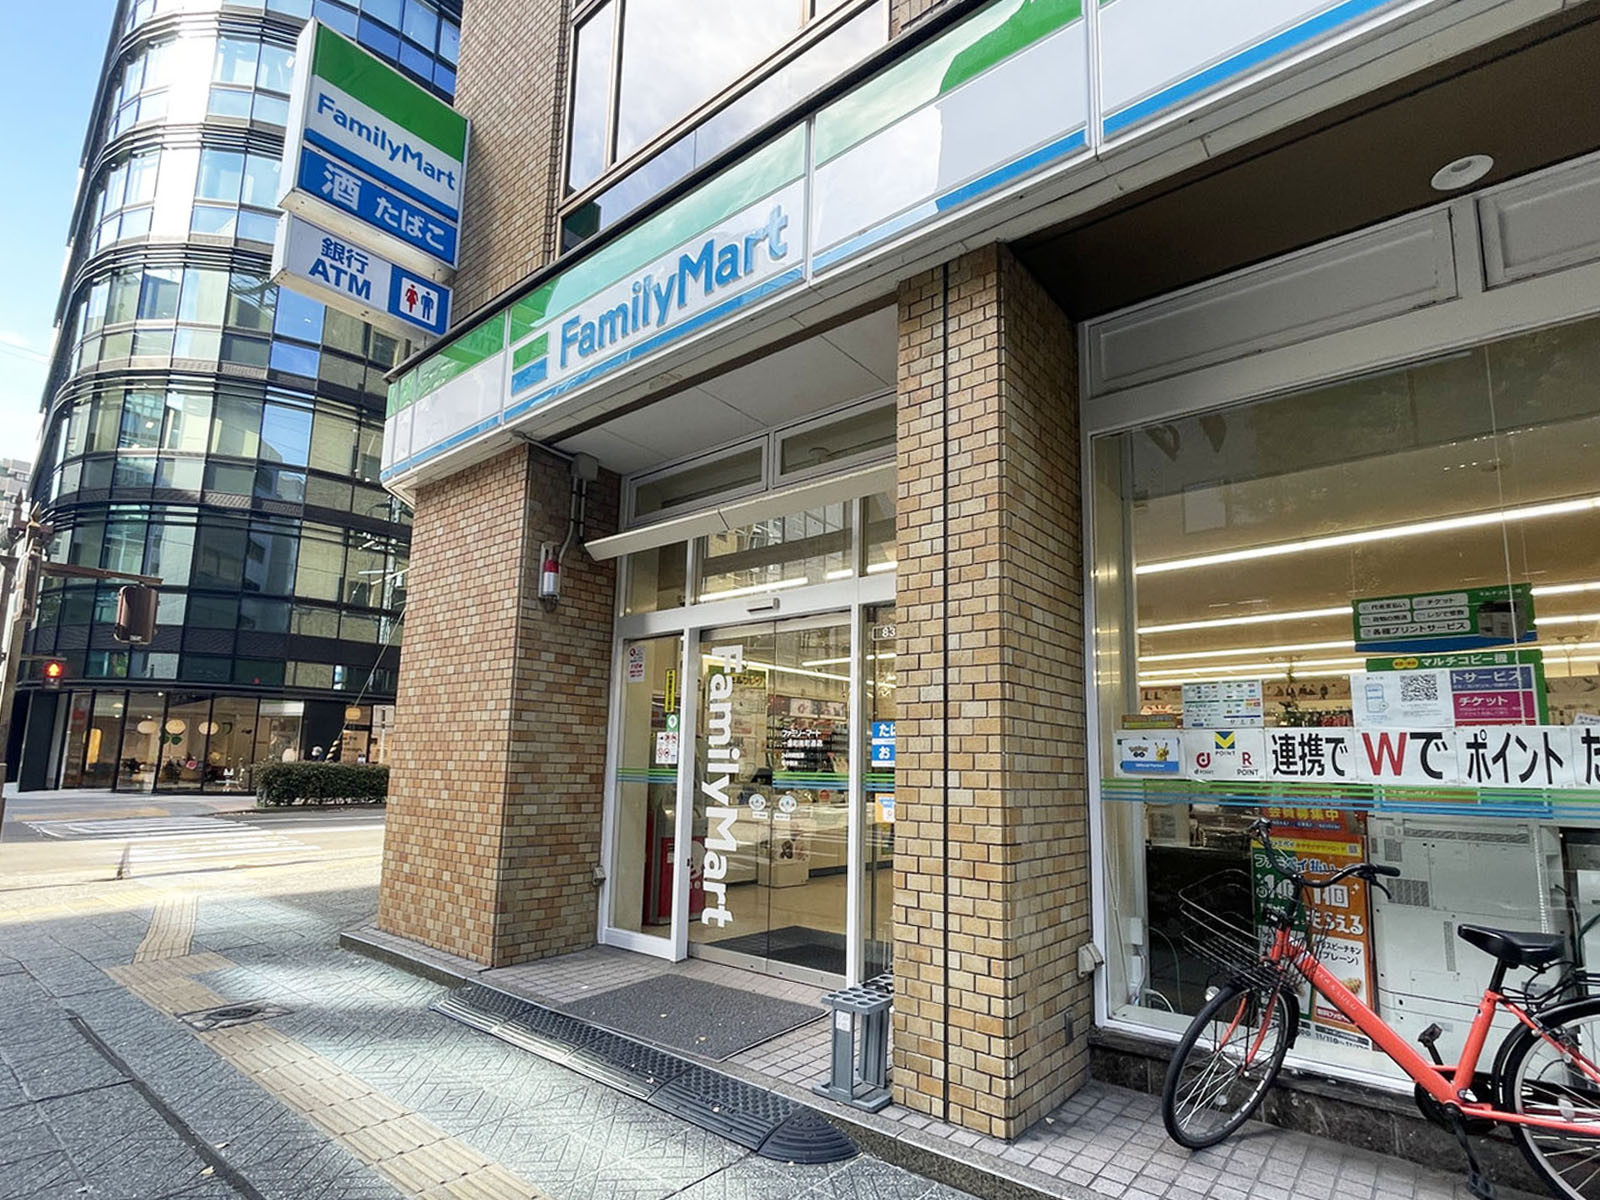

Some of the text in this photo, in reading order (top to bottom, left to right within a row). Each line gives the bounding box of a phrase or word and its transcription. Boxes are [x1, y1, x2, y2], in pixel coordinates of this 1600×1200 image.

[316, 92, 456, 191] FamilyMart
[321, 162, 445, 251] 酒 たばこ
[321, 237, 369, 275] 銀行
[309, 258, 372, 301] ATM
[560, 203, 789, 370] FamilyMart
[1373, 621, 1467, 637] 各種プリントサービス
[1421, 652, 1509, 667] マルチコピー機
[1458, 695, 1508, 706] チケット
[701, 644, 744, 928] FamilyMart
